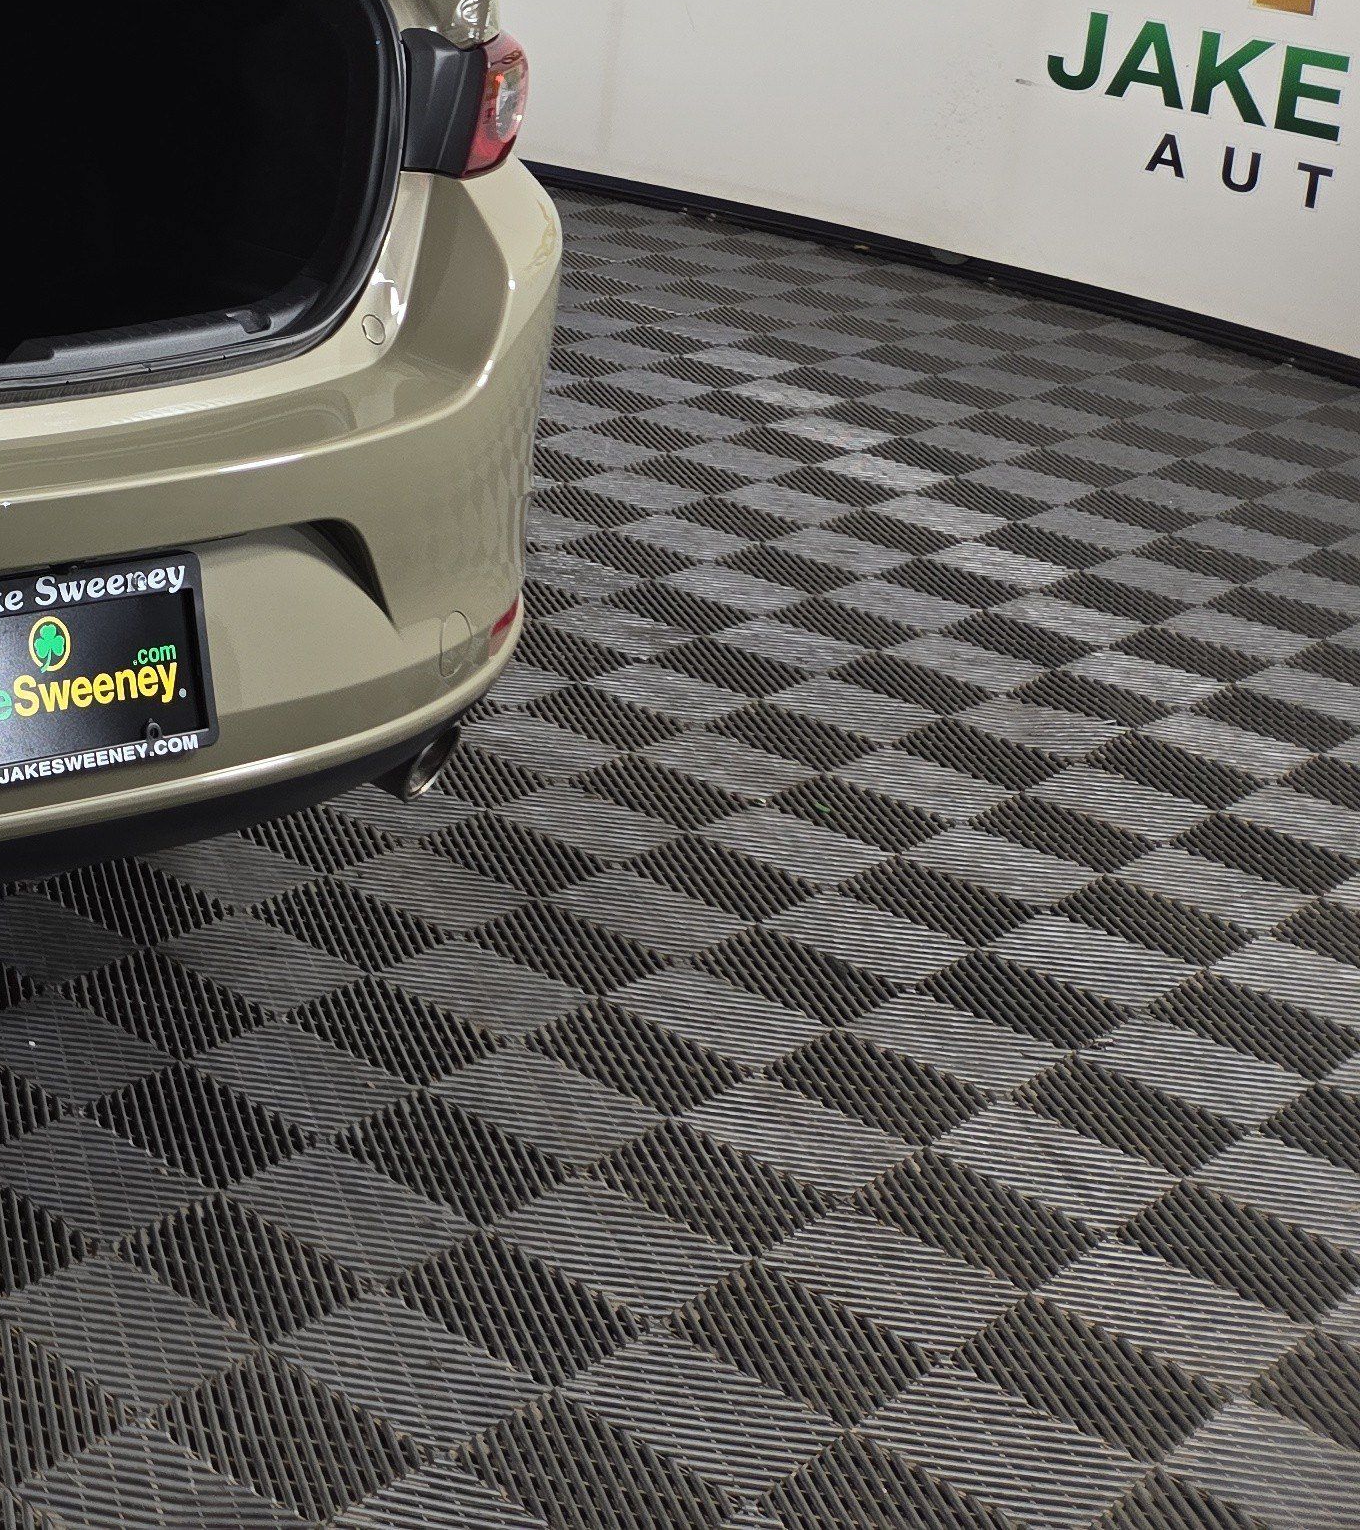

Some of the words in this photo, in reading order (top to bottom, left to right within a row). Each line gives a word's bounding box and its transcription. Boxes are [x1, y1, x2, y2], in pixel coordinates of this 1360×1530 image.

[1047, 11, 1350, 142] JAKE
[34, 564, 186, 607] Sweeney
[132, 644, 177, 667] .com
